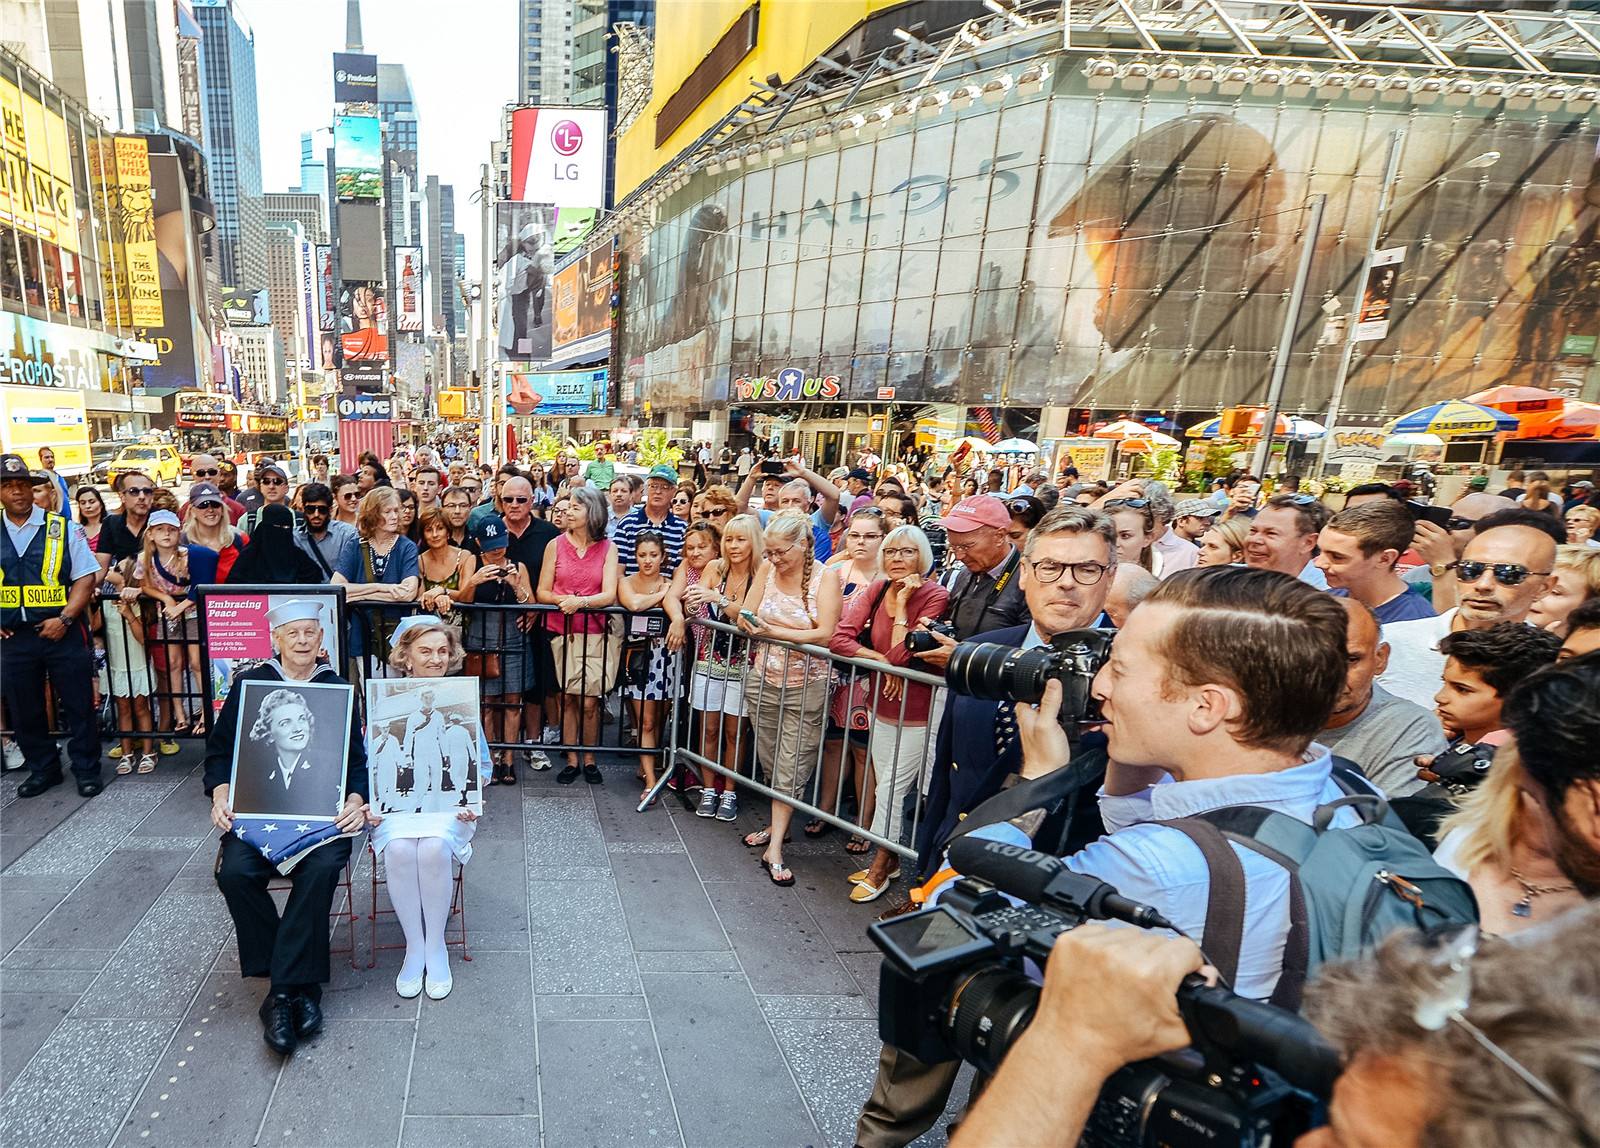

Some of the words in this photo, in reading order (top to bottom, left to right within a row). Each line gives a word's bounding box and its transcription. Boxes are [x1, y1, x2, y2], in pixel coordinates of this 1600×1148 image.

[183, 60, 199, 136] TIMES
[117, 142, 145, 151] EXTRA
[117, 150, 146, 159] SHOW
[121, 159, 145, 168] THIS
[120, 168, 148, 176] WEEK
[554, 163, 579, 180] LG
[751, 174, 958, 242] HALO
[974, 151, 1024, 202] 5
[780, 216, 983, 261] GUARDIANS
[133, 262, 151, 270] THE
[131, 271, 155, 283] LION
[131, 286, 159, 300] KING
[556, 384, 584, 395] RELAX
[803, 375, 841, 397] US
[354, 400, 390, 414] NYC
[1434, 420, 1490, 431] SABRETT
[27, 588, 63, 603] SQUARE
[208, 600, 262, 610] Embracing
[208, 609, 237, 617] Peace
[1170, 1108, 1216, 1139] SONY
